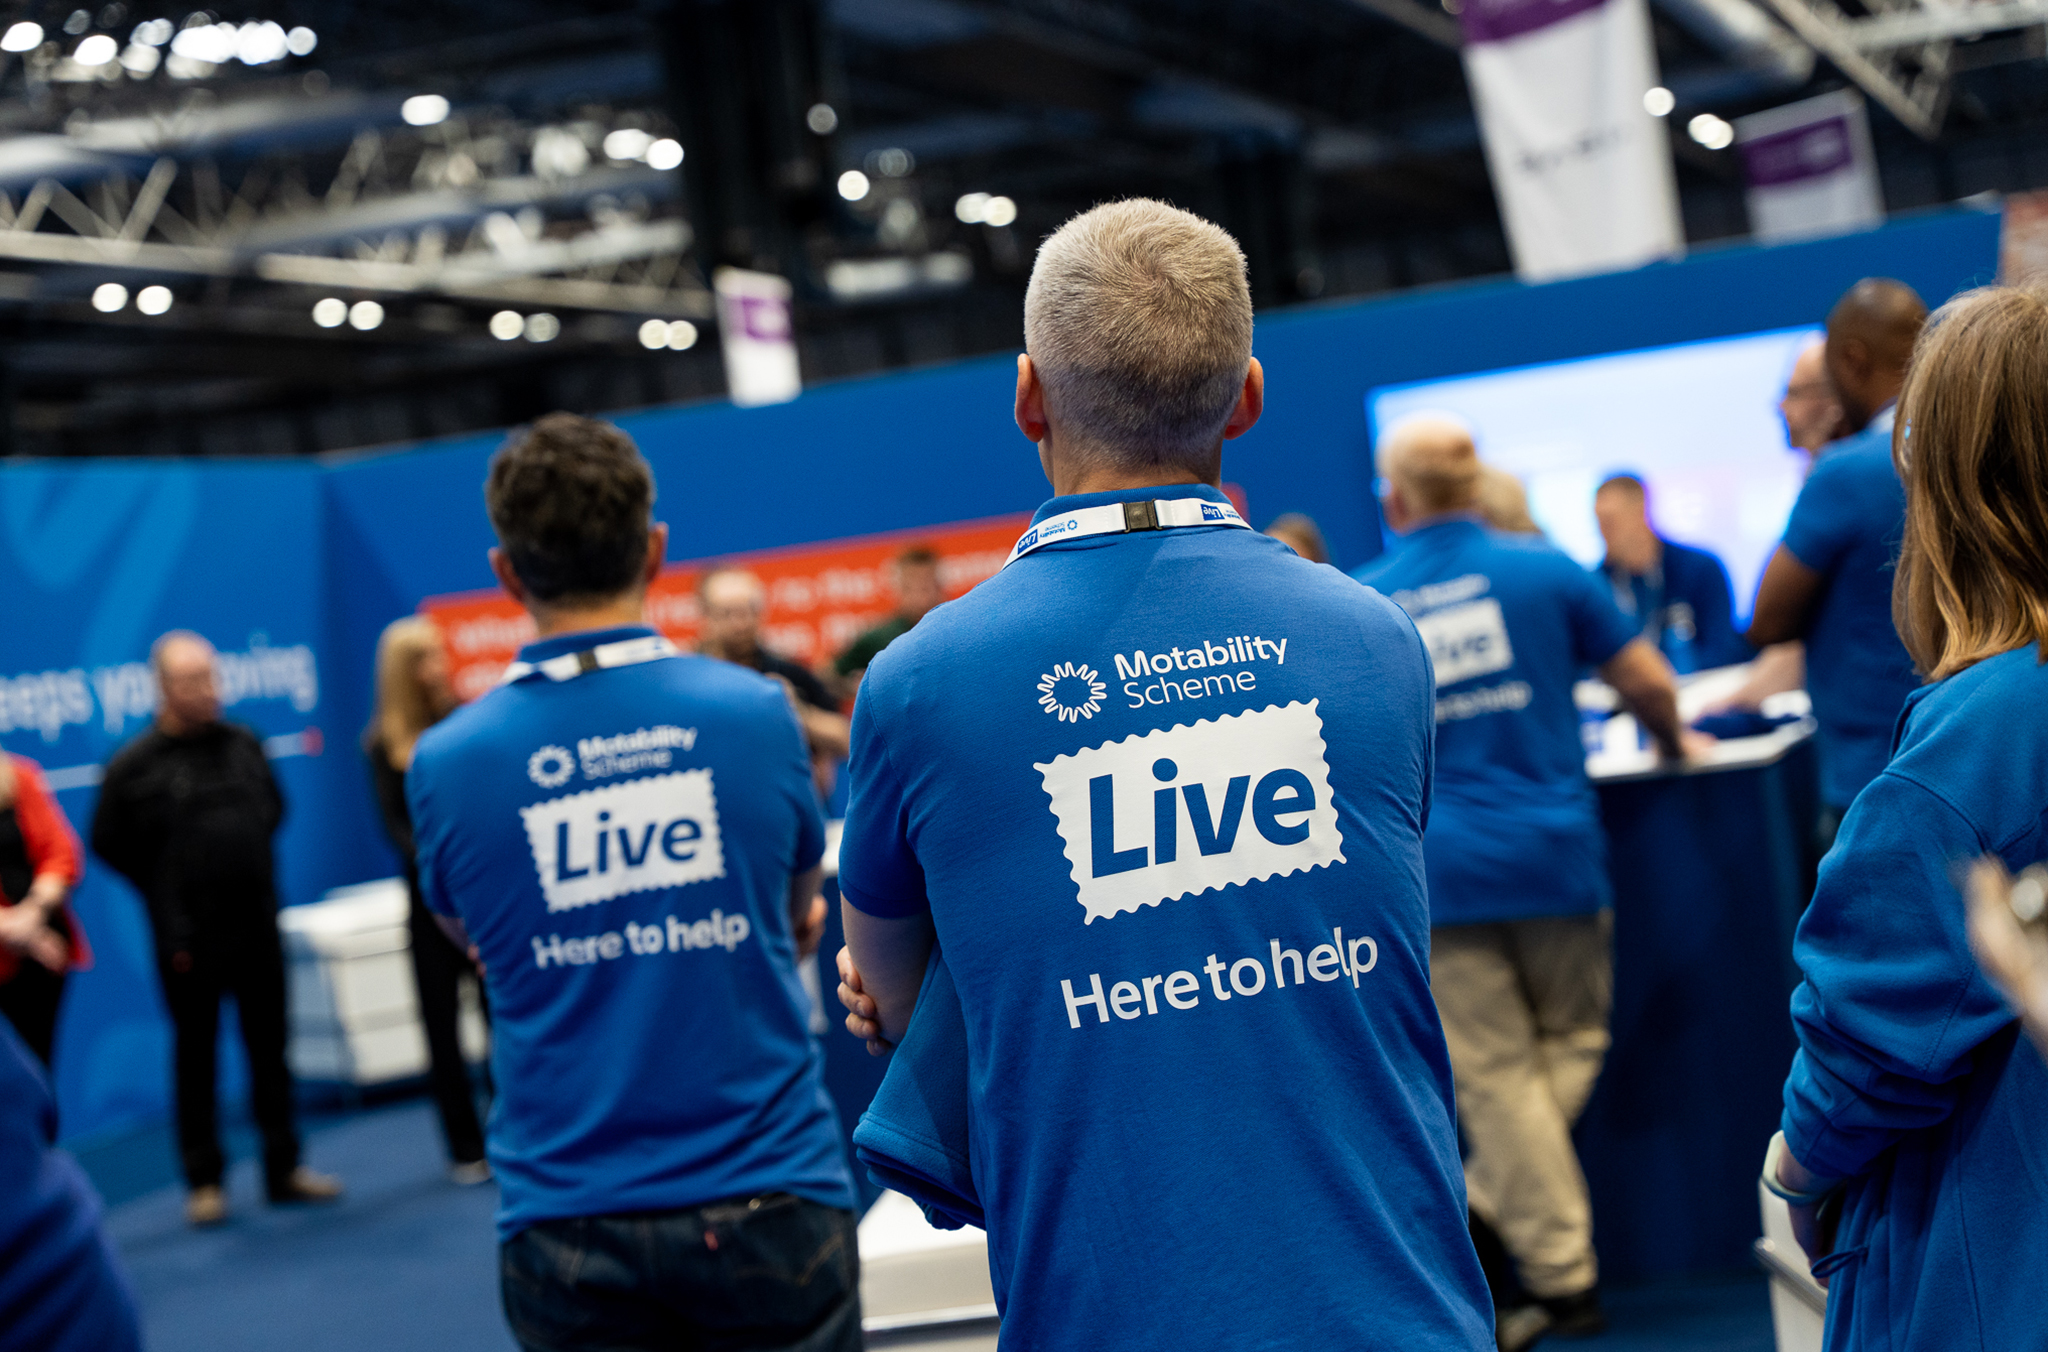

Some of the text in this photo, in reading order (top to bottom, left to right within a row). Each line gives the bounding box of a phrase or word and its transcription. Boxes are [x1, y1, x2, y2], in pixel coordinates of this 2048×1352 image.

[1114, 636, 1288, 680] Motability
[1123, 670, 1257, 710] Scheme
[577, 724, 698, 758] Motability
[581, 749, 673, 781] Scheme
[1088, 756, 1317, 880] Live
[555, 808, 702, 884] Live
[531, 908, 752, 970] Here to help
[1060, 926, 1379, 1029] Here to help
